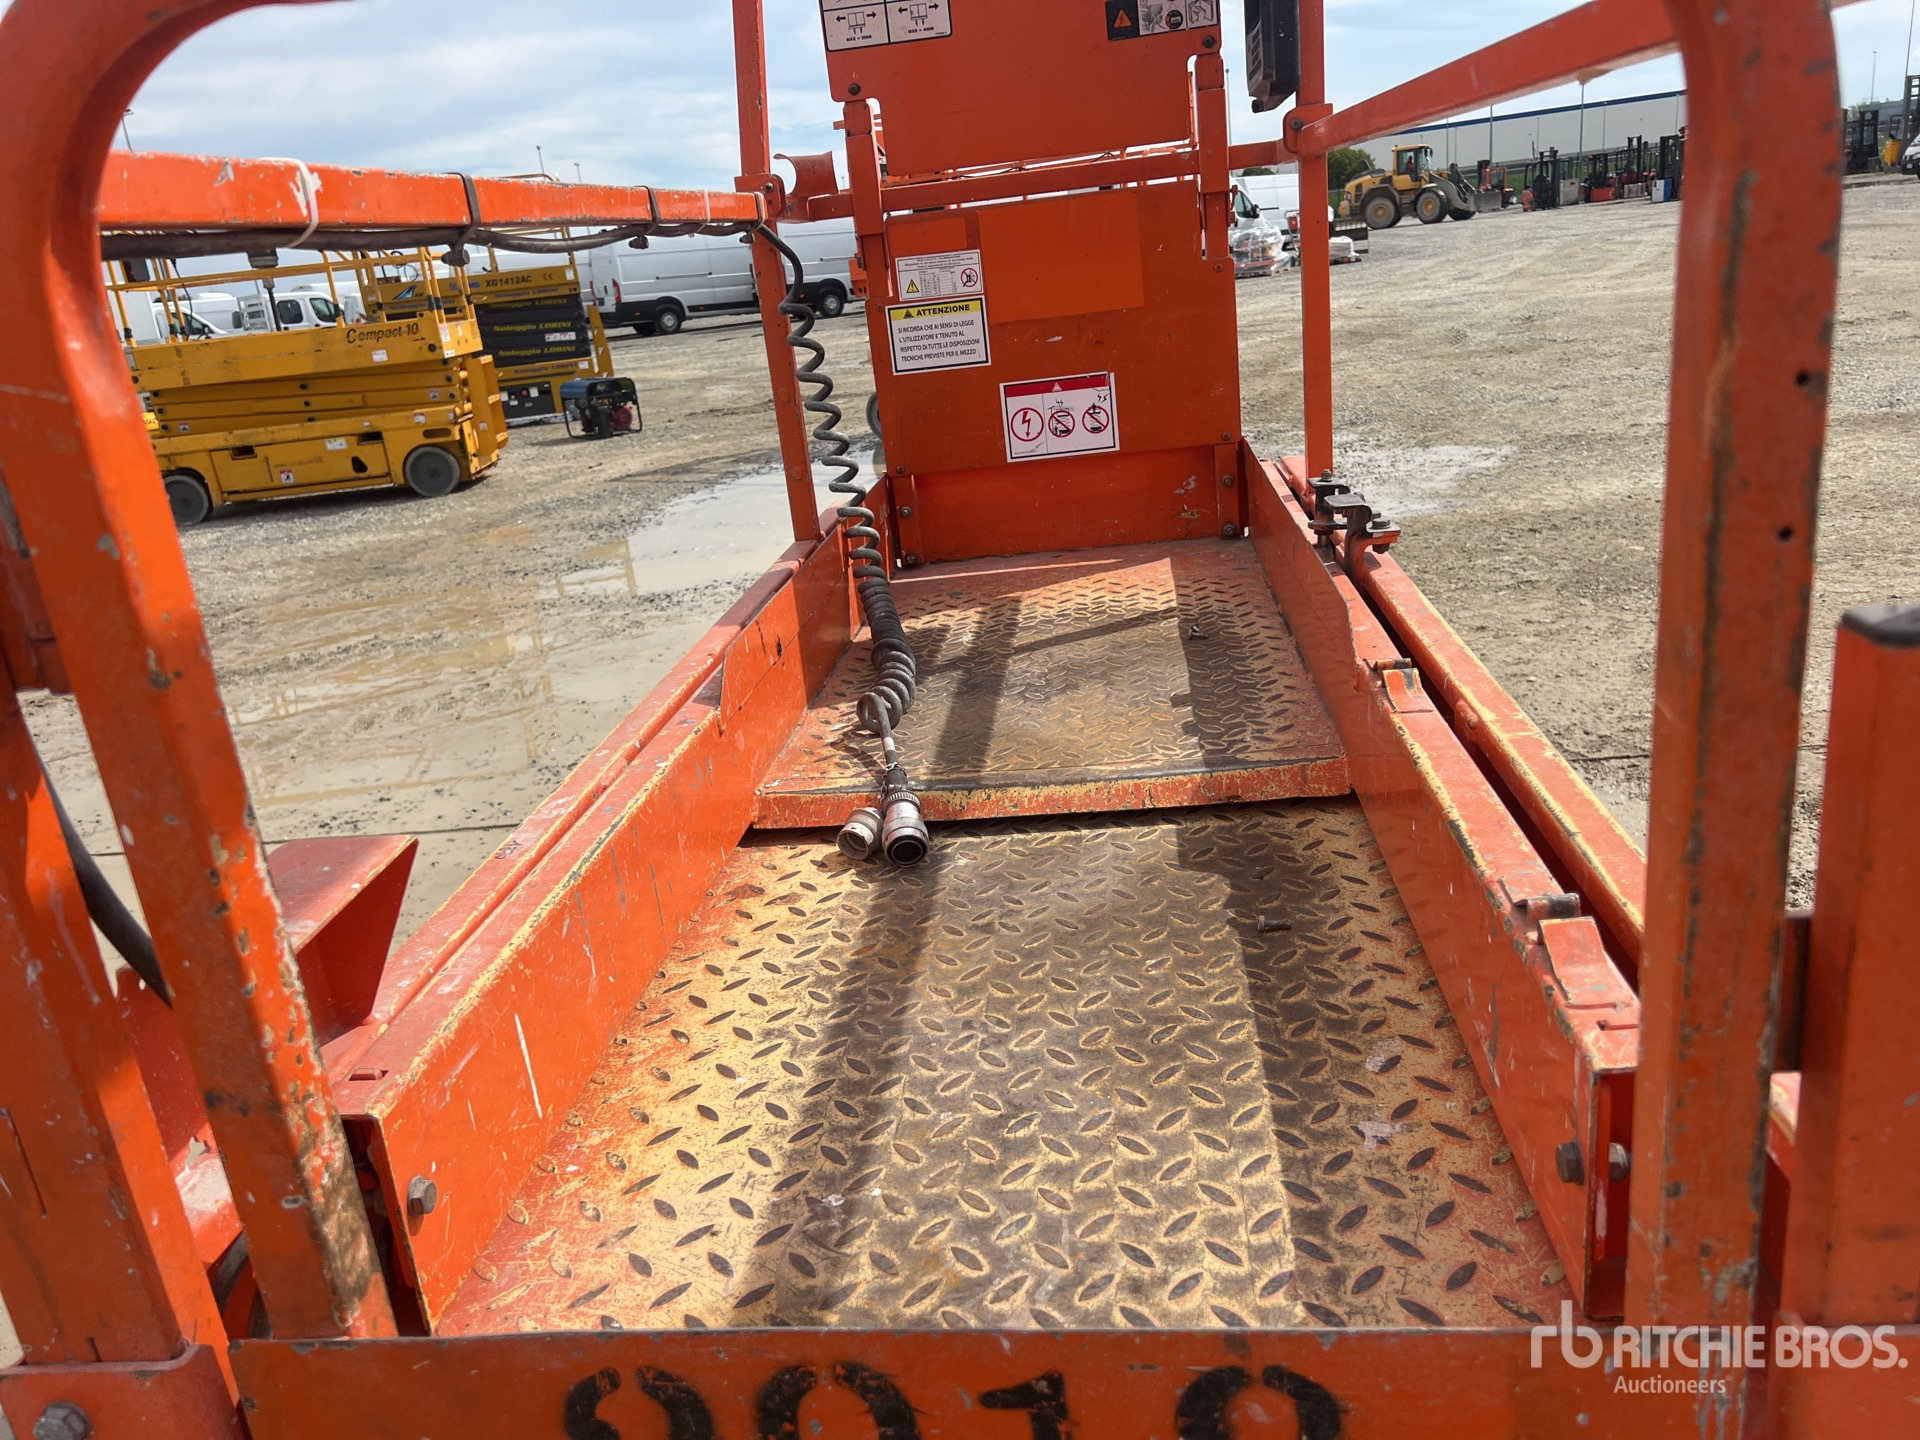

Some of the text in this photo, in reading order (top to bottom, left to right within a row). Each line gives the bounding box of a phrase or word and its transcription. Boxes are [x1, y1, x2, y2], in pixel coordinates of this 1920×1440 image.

[916, 303, 971, 317] ATTENZIONE
[346, 322, 419, 344] Compact 10
[903, 325, 923, 333] RICORDA
[959, 319, 974, 327] LEGGE
[900, 344, 922, 353] RISPETTO
[928, 342, 942, 350] TUTTE
[949, 338, 980, 347] DISPOSIZIONI
[901, 354, 924, 362] TECNICHE
[924, 352, 945, 360] PREVISTE
